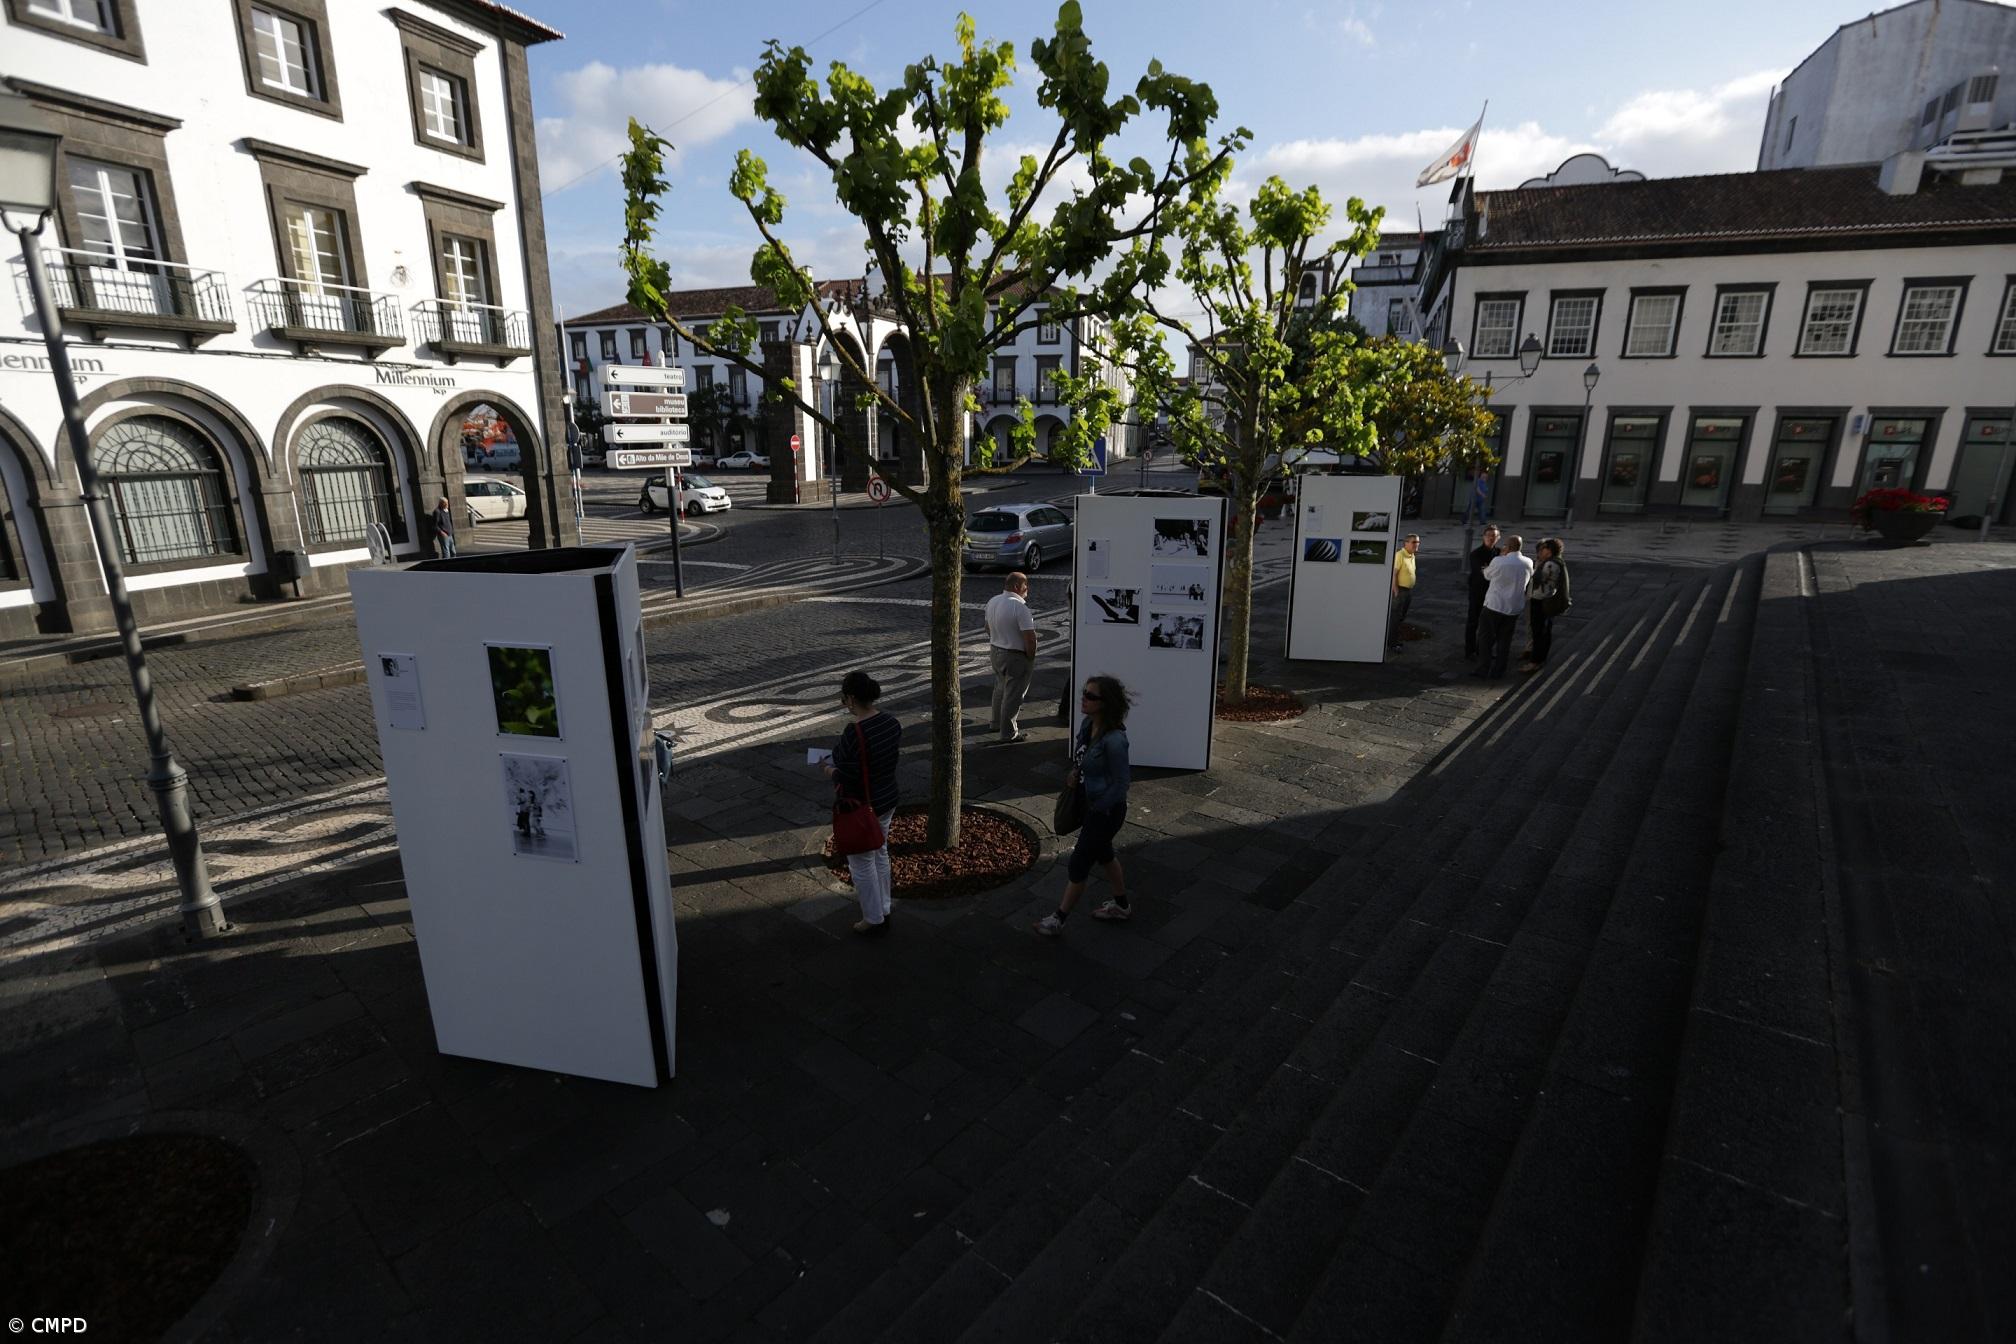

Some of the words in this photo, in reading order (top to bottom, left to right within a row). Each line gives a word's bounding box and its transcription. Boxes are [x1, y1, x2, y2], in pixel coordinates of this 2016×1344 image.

[375, 366, 455, 386] Millennium
[664, 372, 683, 380] teatro
[656, 405, 685, 413] biblioteca
[636, 454, 646, 462] Alto
